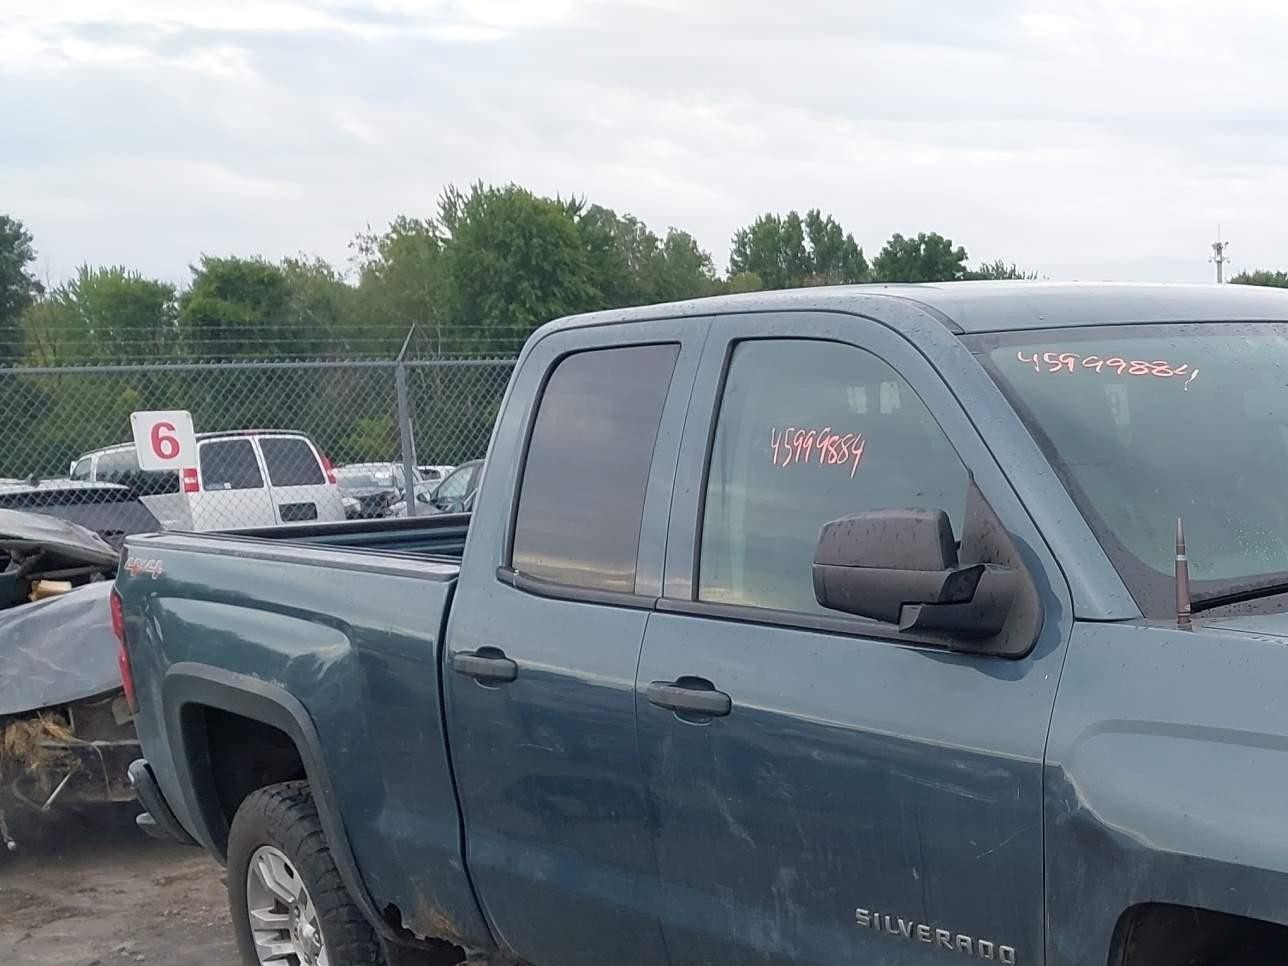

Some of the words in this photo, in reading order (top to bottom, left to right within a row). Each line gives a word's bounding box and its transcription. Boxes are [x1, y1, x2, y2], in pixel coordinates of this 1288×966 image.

[1016, 351, 1200, 392] 45999884
[150, 421, 180, 460] 6
[770, 427, 866, 480] 45999884
[854, 907, 1018, 966] SILVERADO
